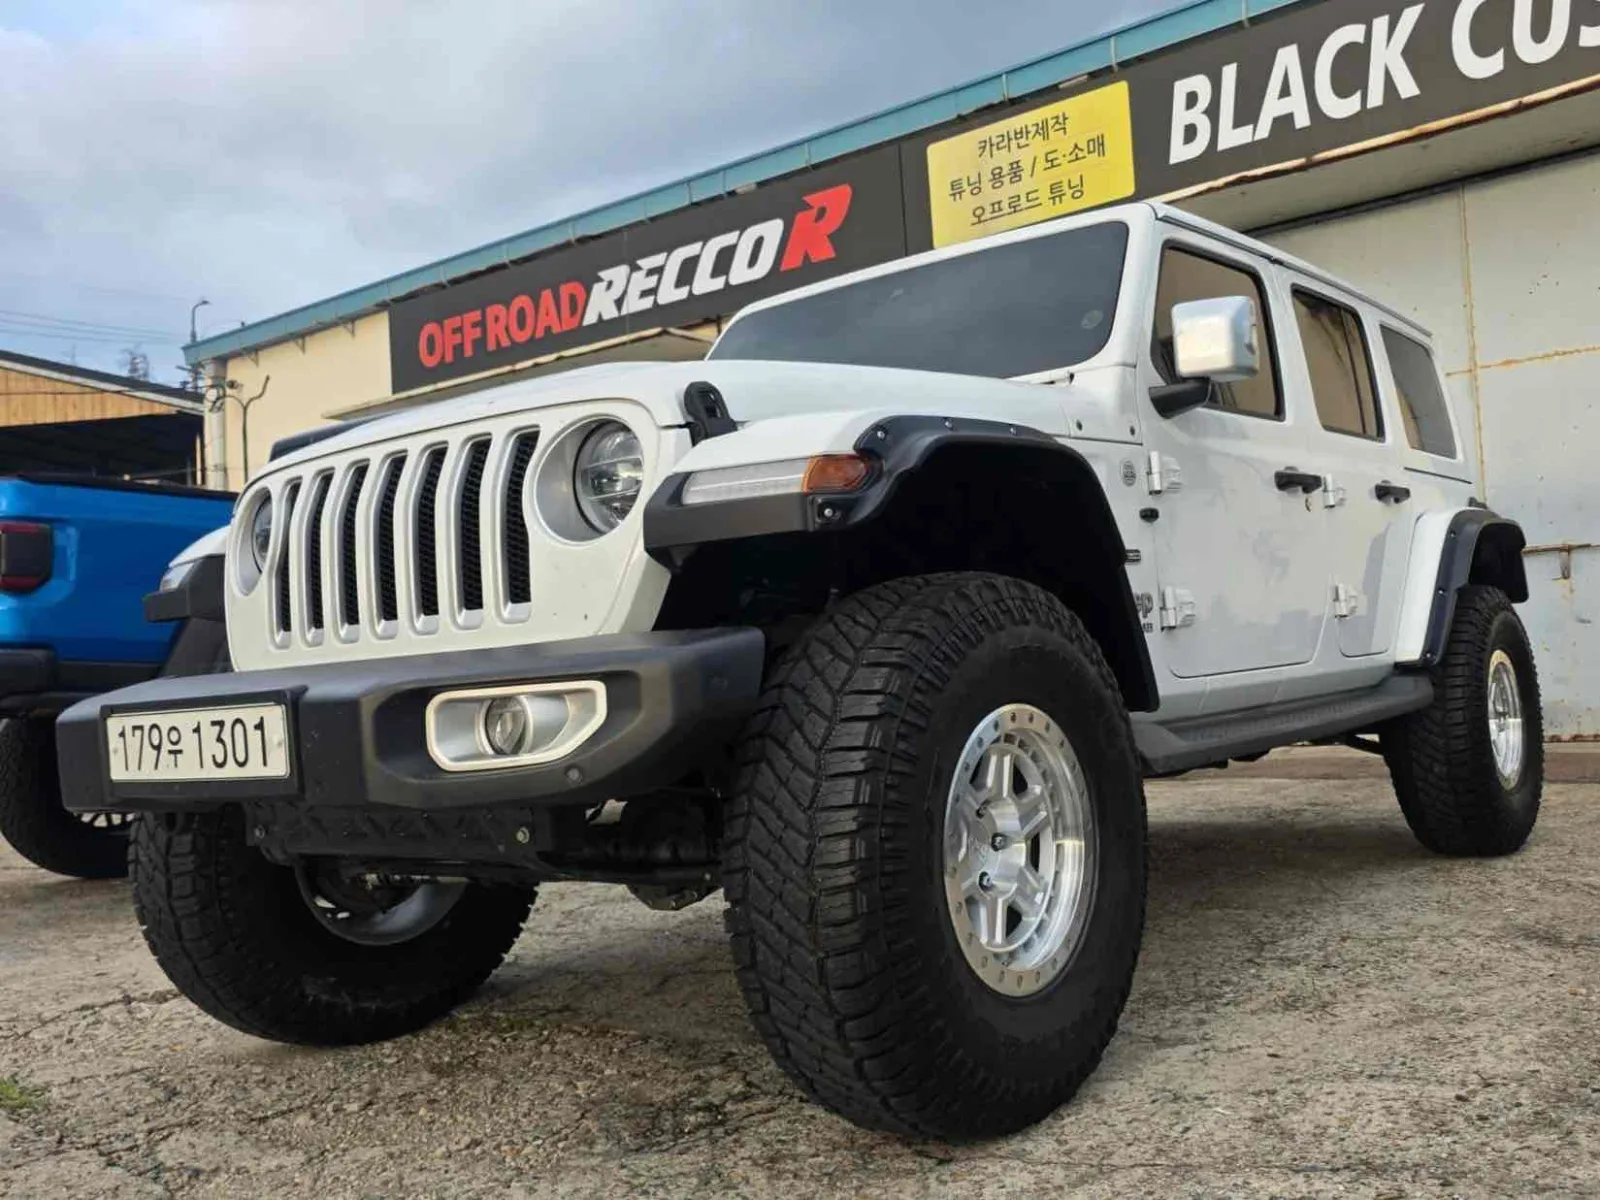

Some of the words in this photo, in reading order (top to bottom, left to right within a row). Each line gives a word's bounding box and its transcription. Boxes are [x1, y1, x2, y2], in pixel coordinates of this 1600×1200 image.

[1169, 3, 1425, 165] BLACK
[978, 112, 1069, 158] 카라반제작
[949, 173, 982, 202] 튜닝
[989, 159, 1025, 190] 용품
[971, 188, 1043, 226] 오프로드
[1048, 174, 1085, 205] 튜닝
